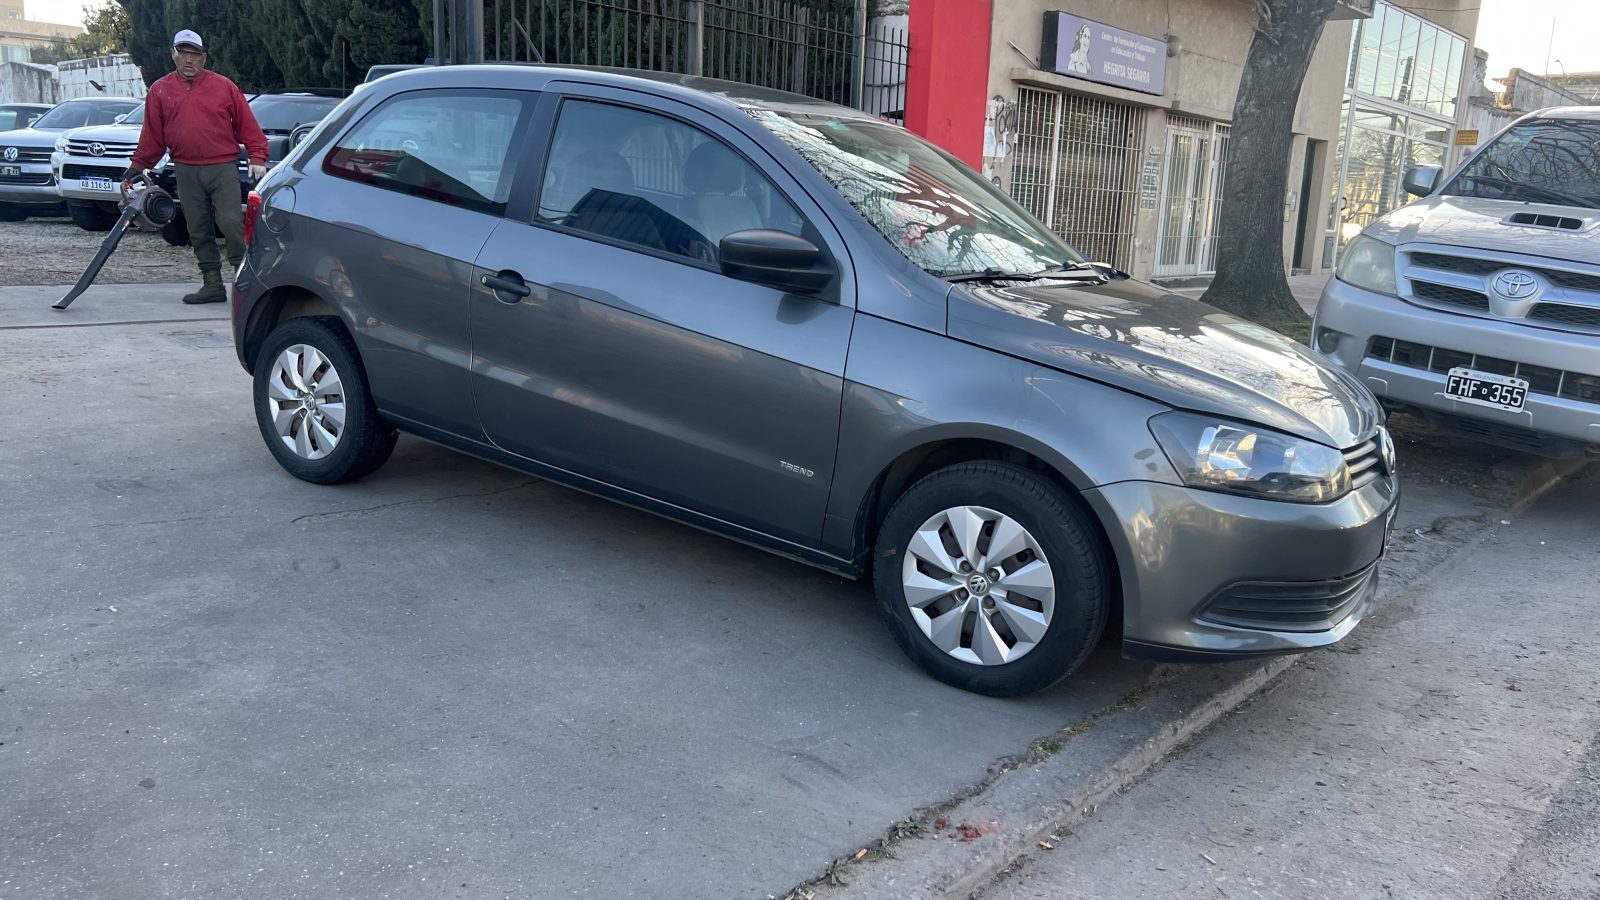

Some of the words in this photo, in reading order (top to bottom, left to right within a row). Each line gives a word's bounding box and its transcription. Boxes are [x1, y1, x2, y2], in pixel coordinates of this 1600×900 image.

[1103, 61, 1126, 79] NEGRITA
[1126, 66, 1150, 84] SEGARRA
[1448, 376, 1480, 398] FHF
[1489, 384, 1524, 407] 355
[780, 460, 814, 477] TREND
